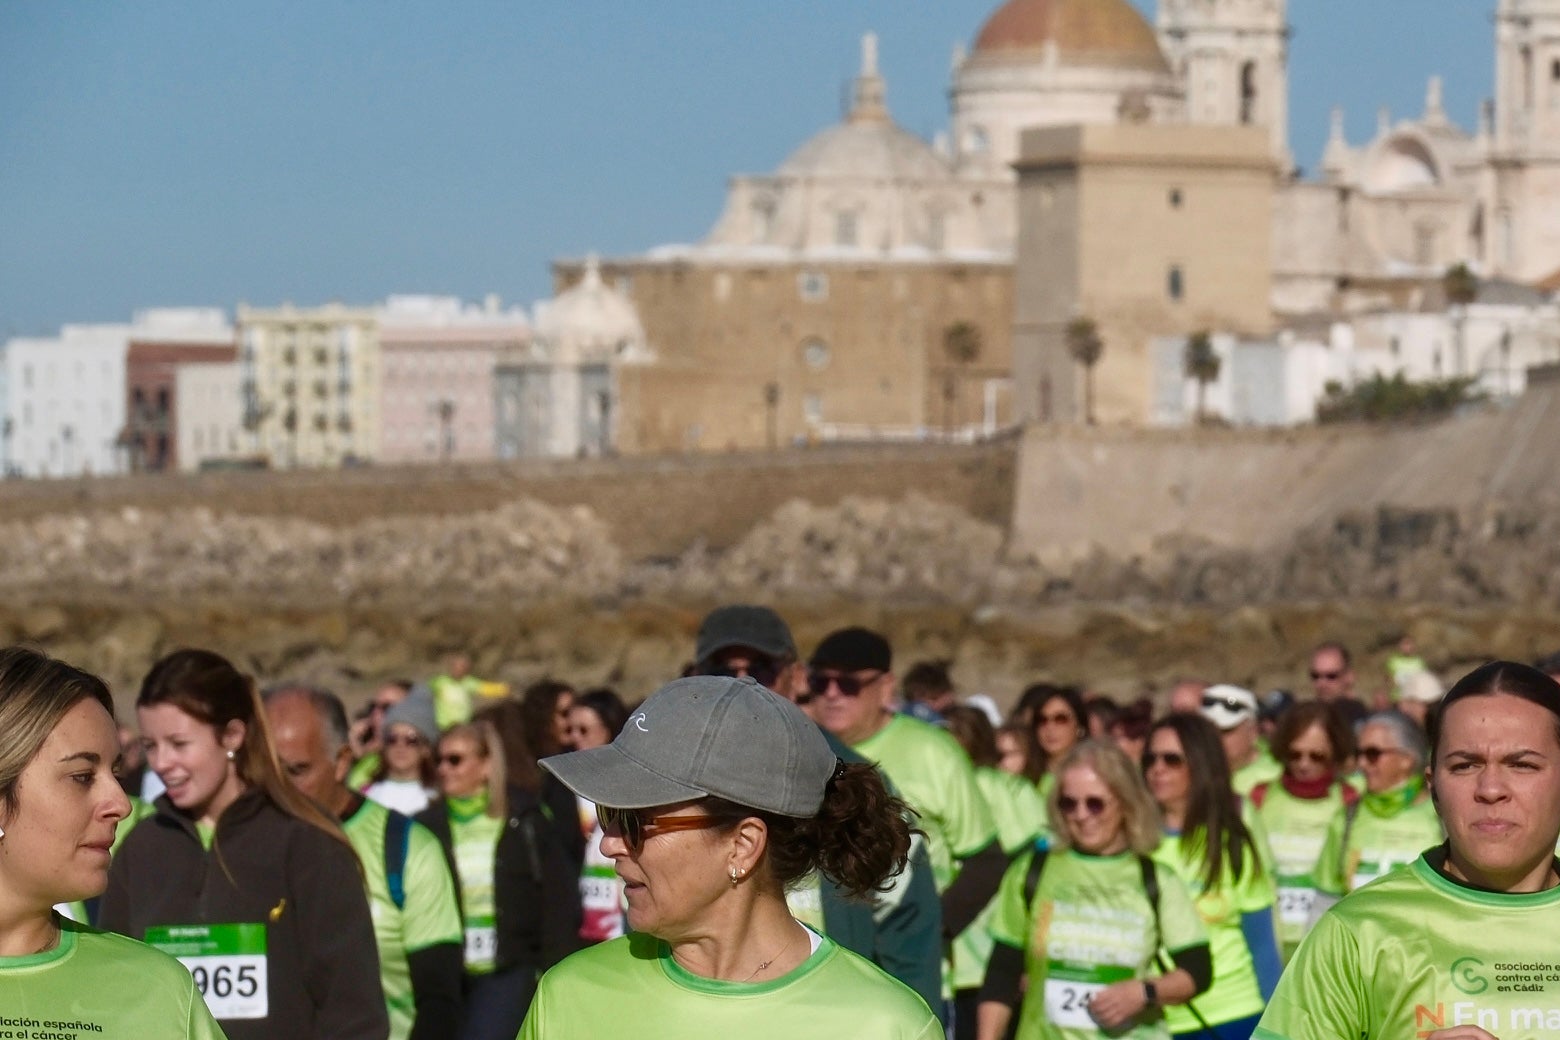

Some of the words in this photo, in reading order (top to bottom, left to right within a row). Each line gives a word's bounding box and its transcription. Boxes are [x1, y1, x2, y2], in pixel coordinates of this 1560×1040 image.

[1494, 961, 1552, 972] asociación
[192, 965, 259, 998] 965
[1496, 973, 1532, 982] contra
[1534, 973, 1544, 982] el
[1497, 984, 1512, 992] en
[1513, 983, 1545, 993] Cádiz
[1453, 1002, 1499, 1031] En
[43, 1019, 103, 1033] española
[16, 1029, 28, 1040] el
[32, 1030, 78, 1040] cáncer
